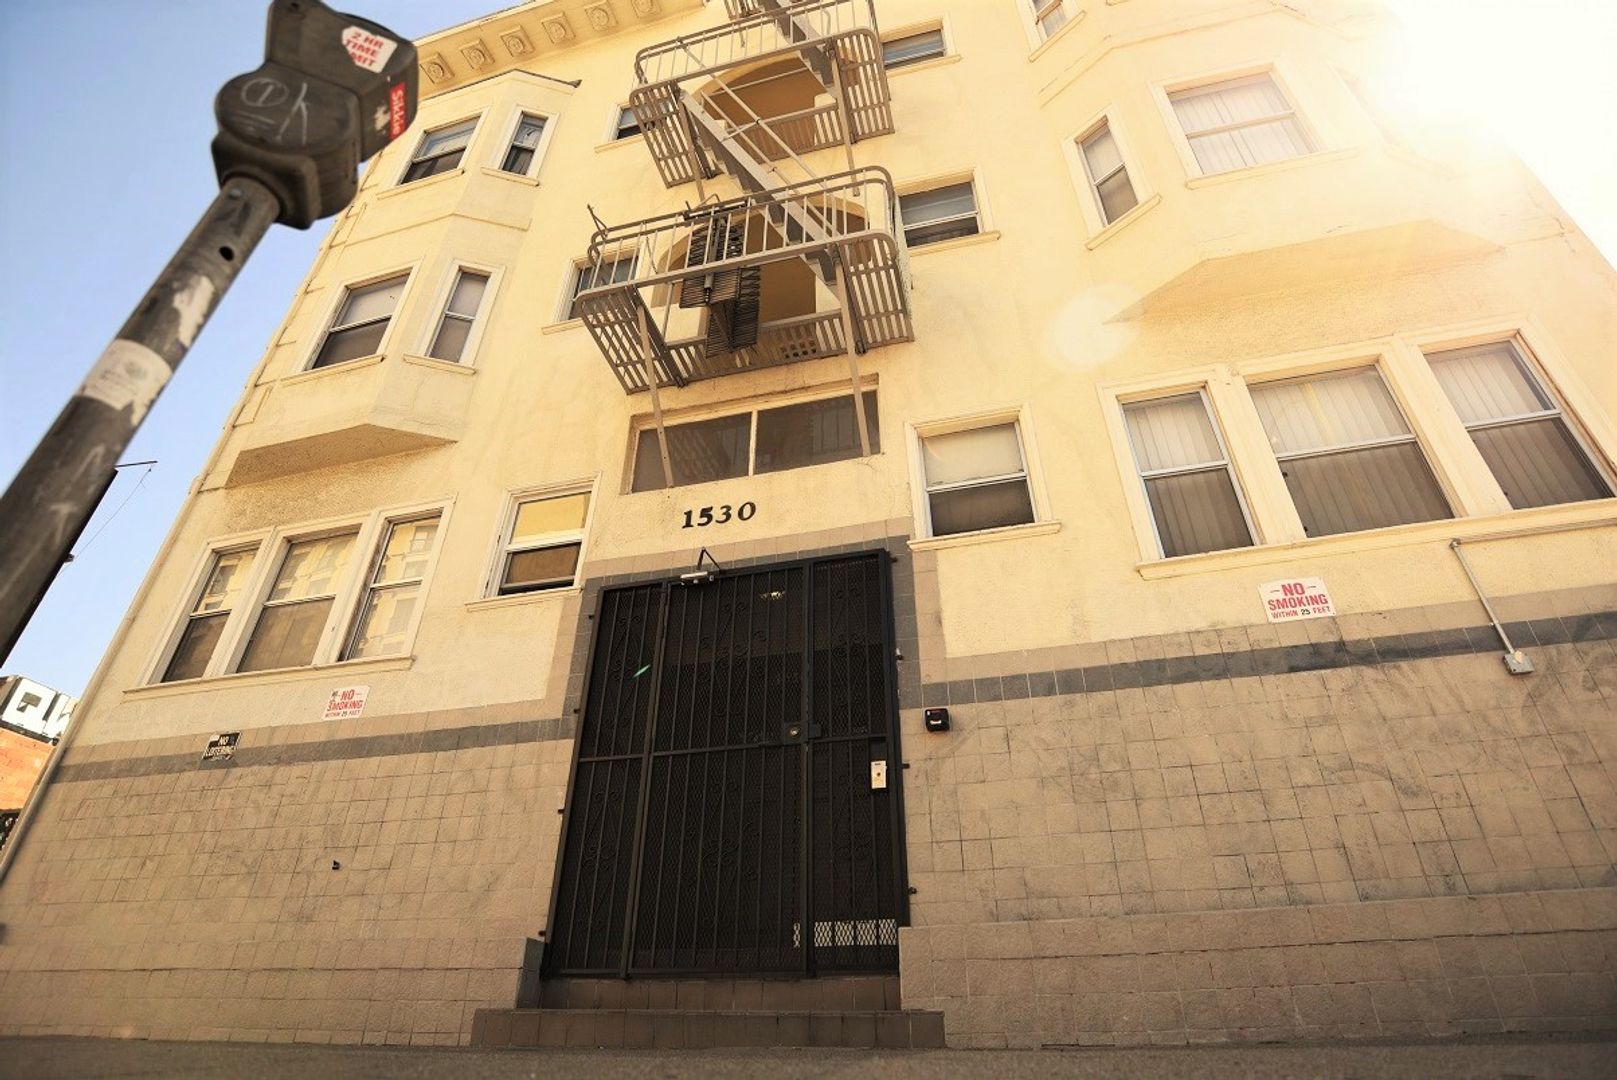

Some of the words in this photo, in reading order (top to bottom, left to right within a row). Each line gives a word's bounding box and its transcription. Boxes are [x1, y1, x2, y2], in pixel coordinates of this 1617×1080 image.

[346, 39, 380, 57] TIME
[363, 36, 384, 49] HR
[682, 501, 757, 529] 1530
[1281, 582, 1306, 597] NO
[1267, 593, 1329, 611] SMOKING
[1271, 610, 1299, 619] WITHIN
[1300, 608, 1311, 616] 25
[1312, 606, 1331, 614] FEET
[340, 689, 355, 700] NO
[326, 700, 364, 711] SMOKING
[217, 736, 230, 746] NO
